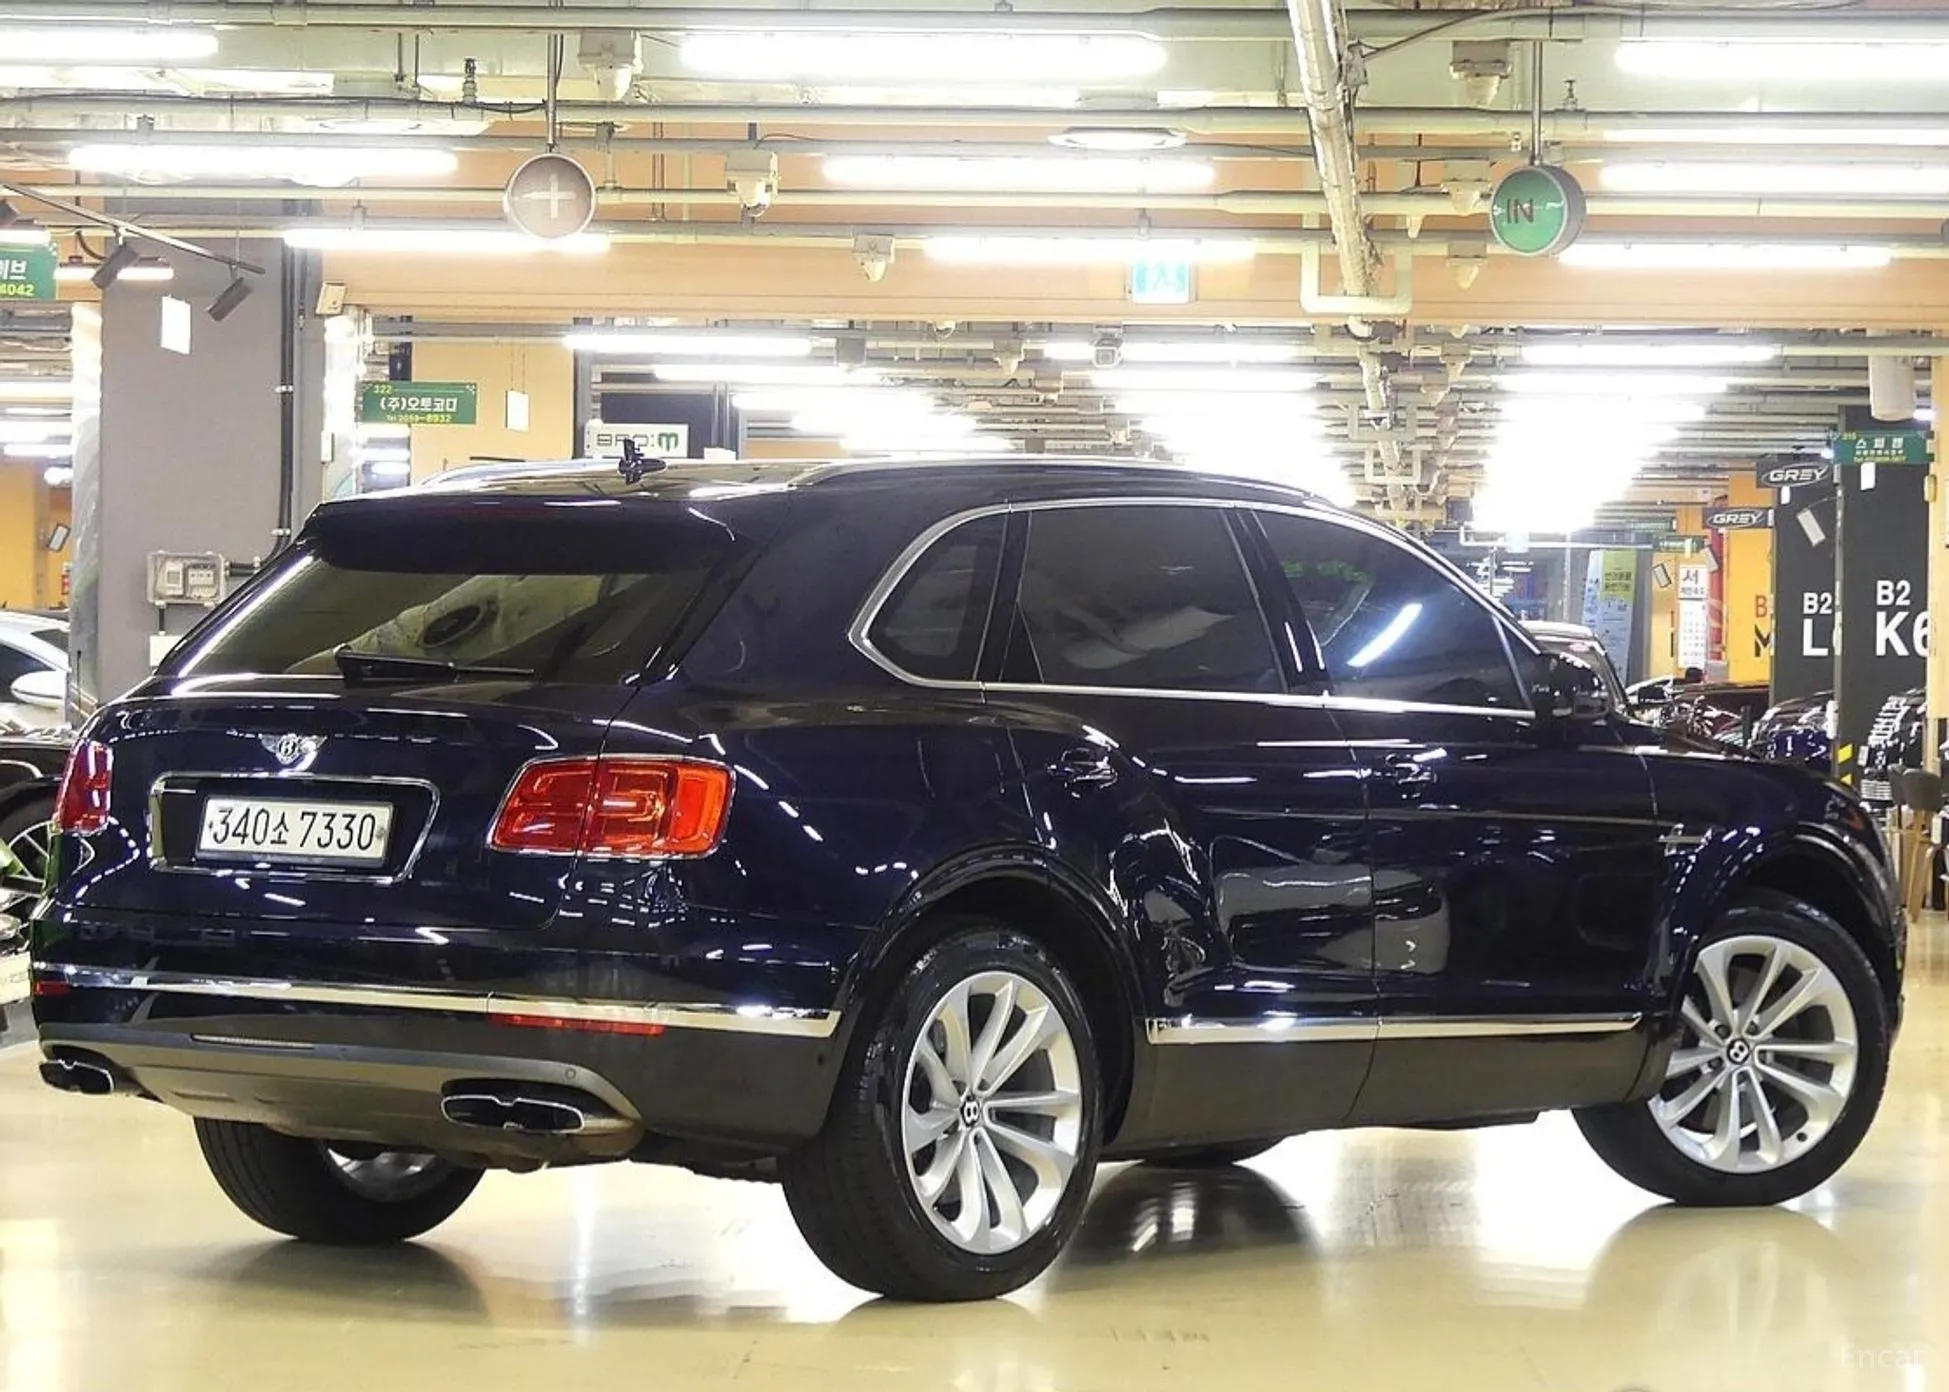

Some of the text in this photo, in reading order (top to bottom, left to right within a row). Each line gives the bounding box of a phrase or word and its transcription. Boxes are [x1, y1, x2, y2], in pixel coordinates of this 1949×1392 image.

[1507, 198, 1535, 224] IN
[1769, 468, 1825, 482] GREY
[1713, 513, 1761, 524] GREY
[1803, 592, 1833, 614] B2
[1876, 580, 1911, 606] B2
[1755, 594, 1774, 618] B
[213, 808, 376, 850] 340소 7330
